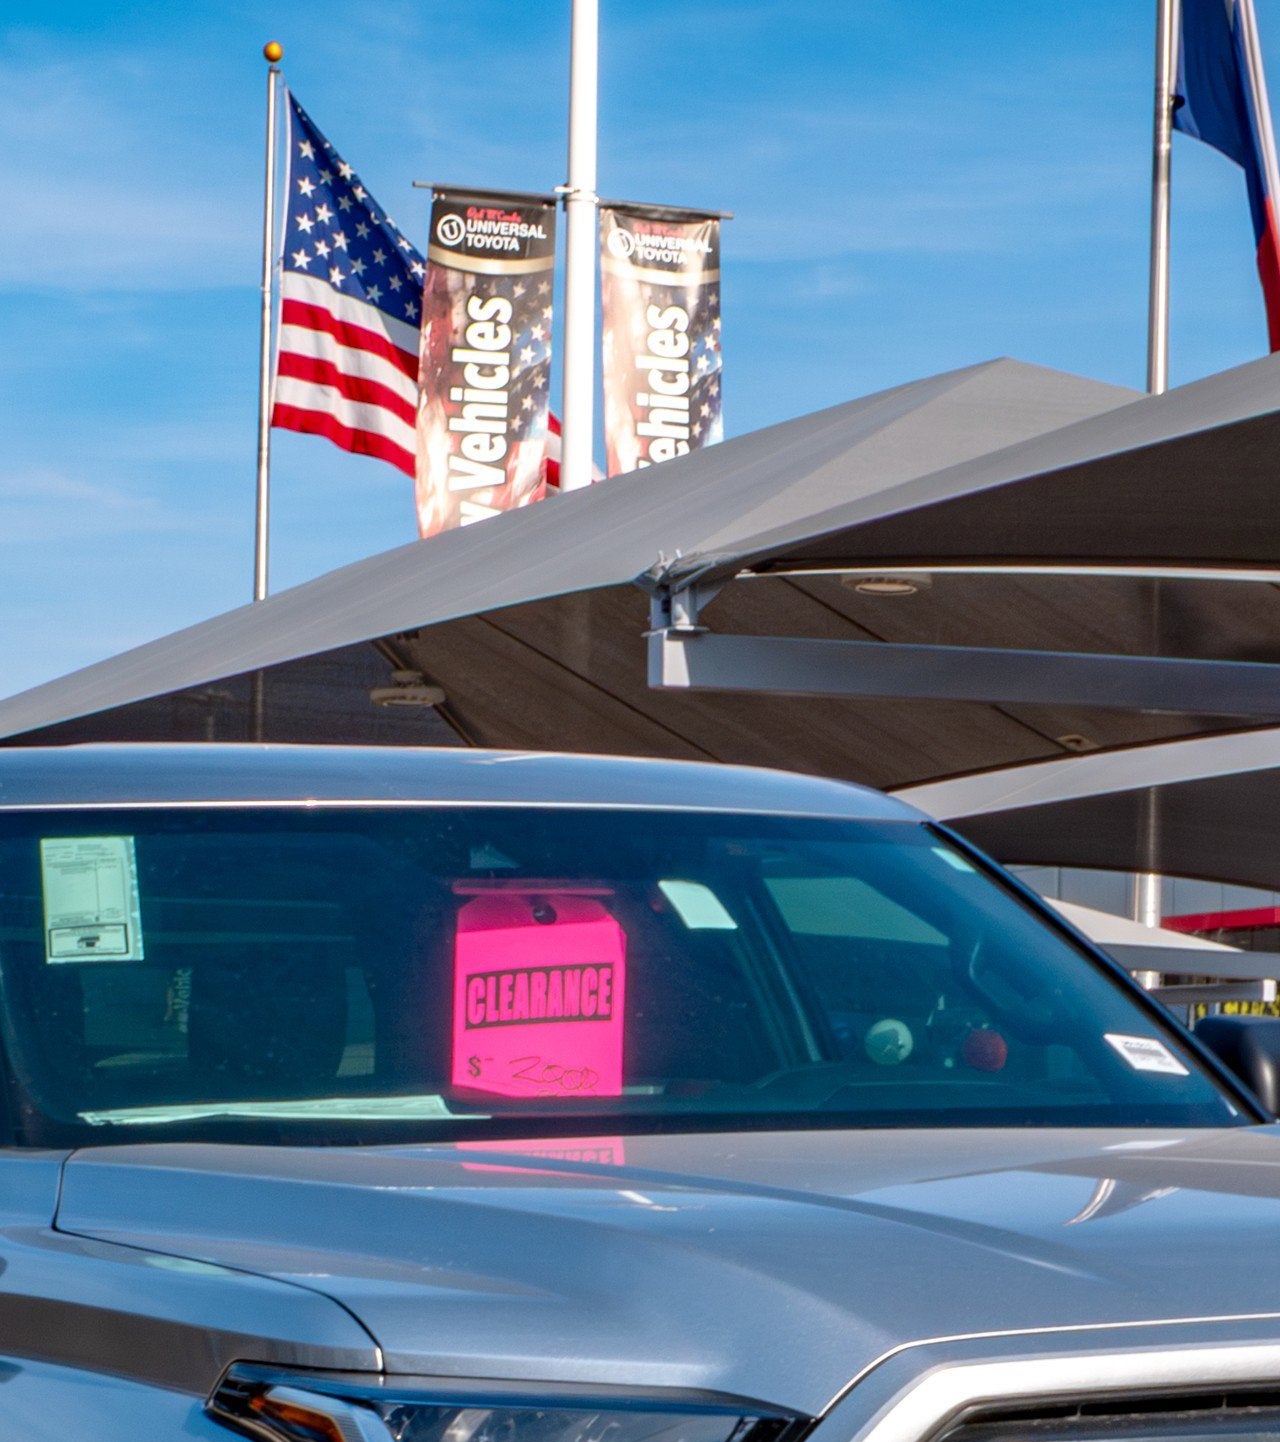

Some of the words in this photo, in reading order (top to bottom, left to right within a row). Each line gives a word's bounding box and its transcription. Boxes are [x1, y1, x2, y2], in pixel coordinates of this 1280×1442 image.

[466, 233, 520, 252] TOYOTA
[467, 218, 548, 239] UNIVERSAL
[634, 246, 688, 264] TOYOTA
[447, 294, 513, 492] Vehicles
[634, 303, 690, 467] ehicles
[467, 966, 612, 1026] CLEARANCE
